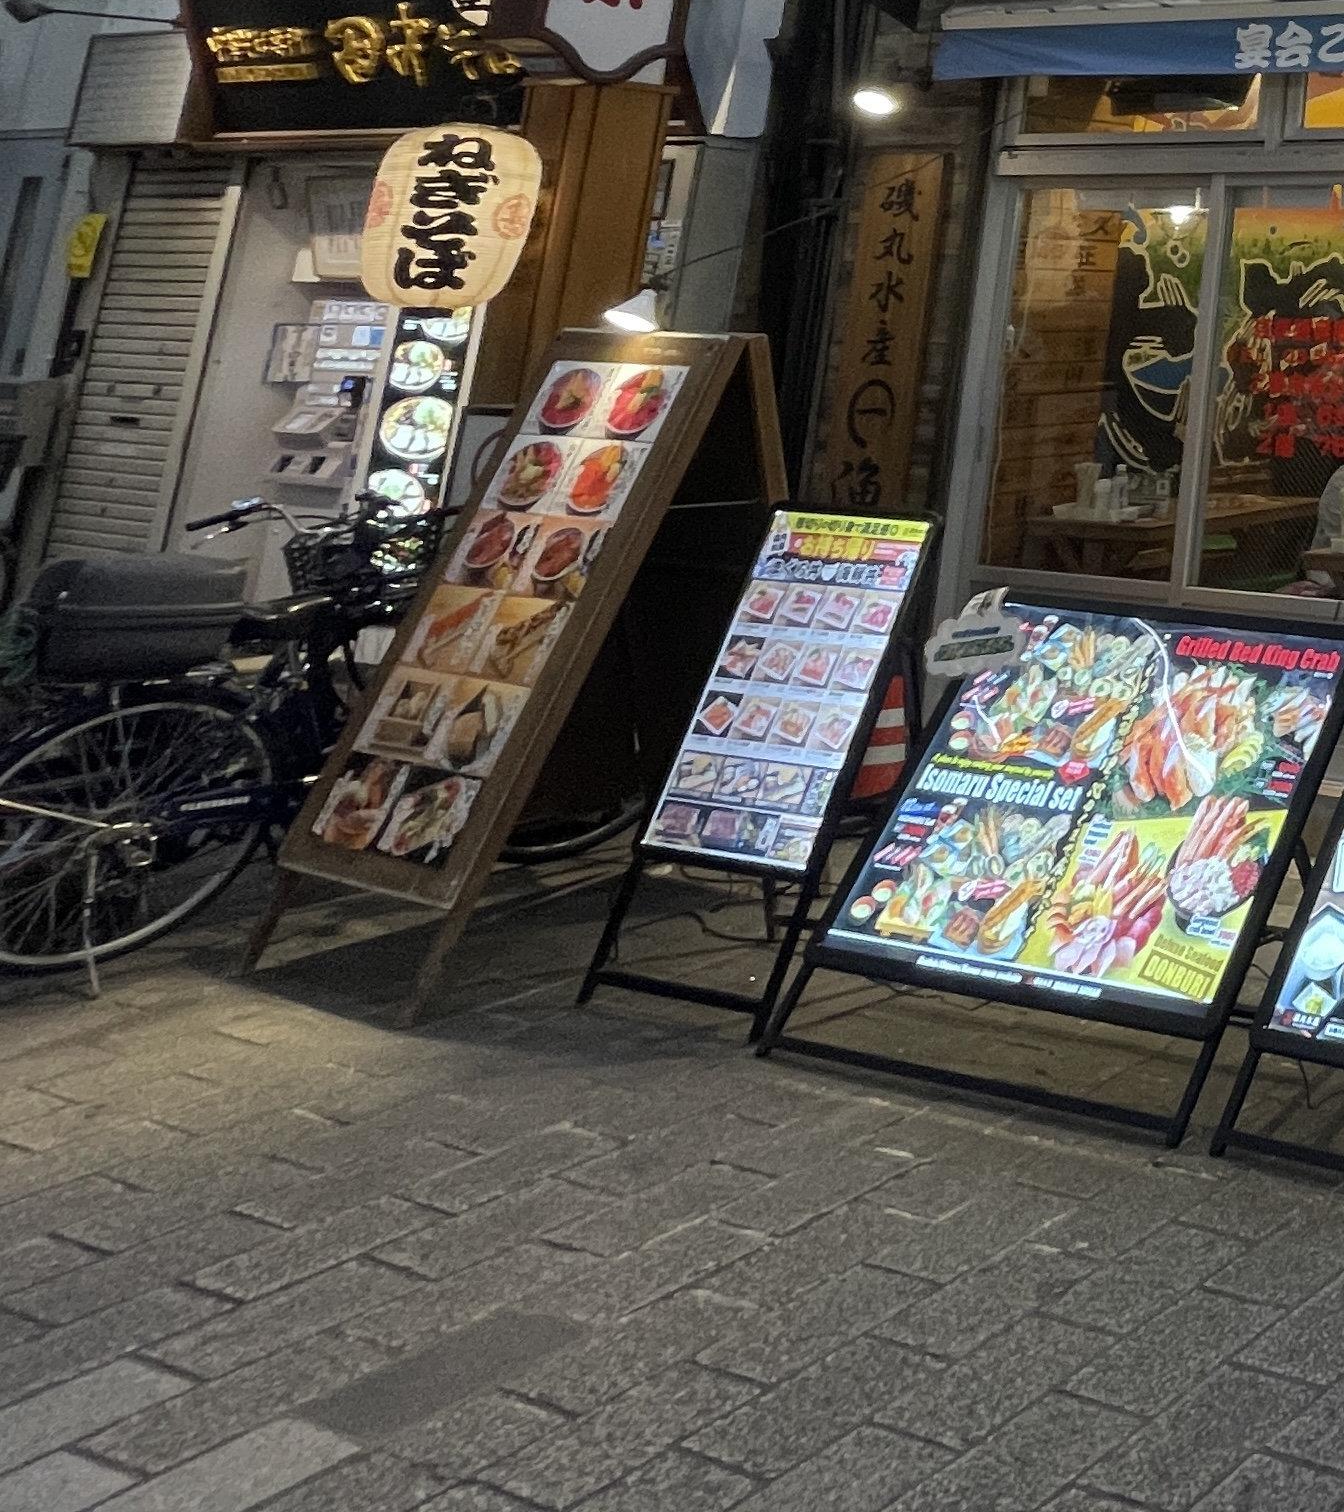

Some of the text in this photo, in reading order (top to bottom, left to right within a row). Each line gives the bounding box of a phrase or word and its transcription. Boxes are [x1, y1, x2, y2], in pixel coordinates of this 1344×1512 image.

[393, 133, 500, 290] ねぎそば
[915, 763, 988, 799] Isomaru
[985, 774, 1054, 809] Special
[1049, 785, 1084, 812] set
